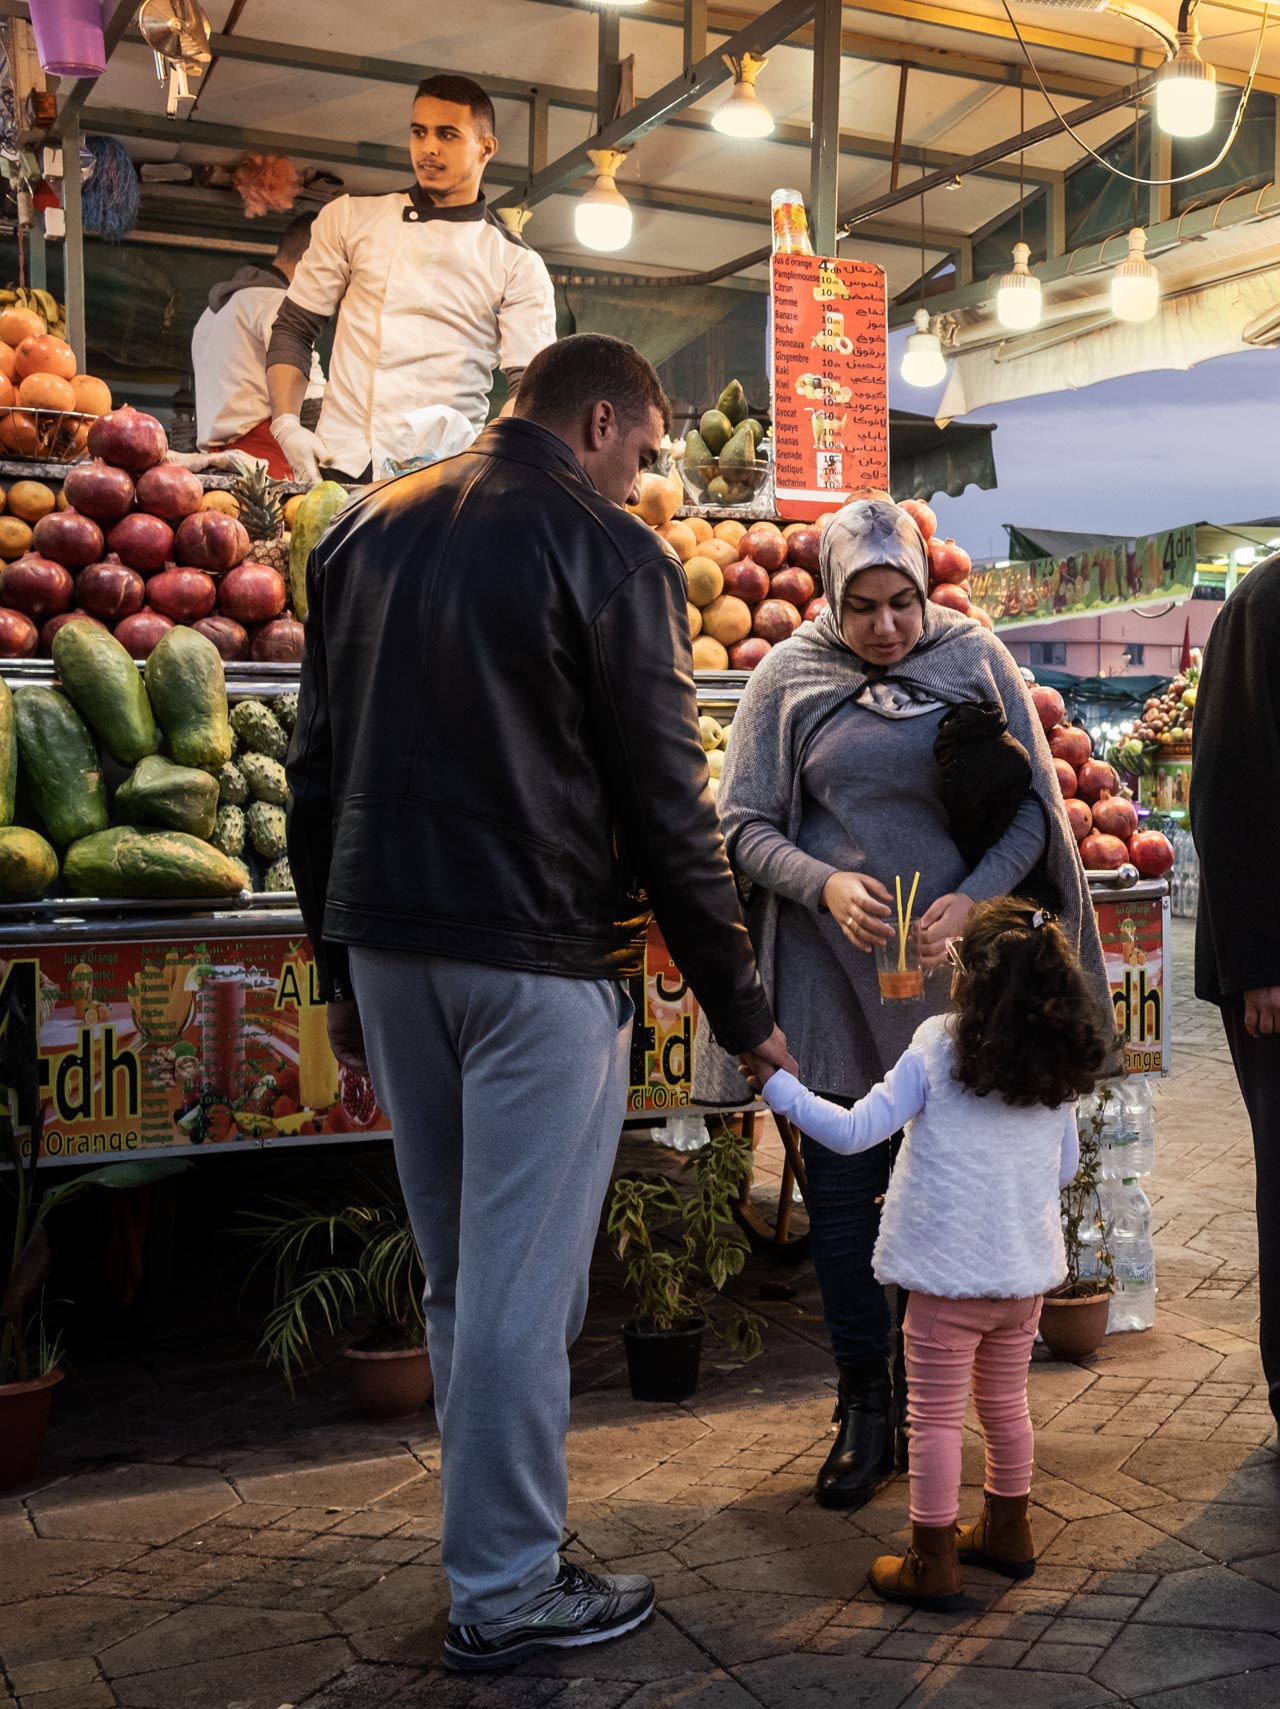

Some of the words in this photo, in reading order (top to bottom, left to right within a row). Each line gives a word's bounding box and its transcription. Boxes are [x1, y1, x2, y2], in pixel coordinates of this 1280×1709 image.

[774, 256, 784, 265] Jus
[785, 257, 812, 269] d'orange
[774, 269, 820, 283] Pamplemousse
[774, 282, 793, 292] Citron
[775, 297, 798, 307] Pomme
[776, 323, 793, 333] Peche
[866, 320, 885, 330] موز
[776, 338, 804, 348] Pruneaux
[776, 353, 809, 363] Gingembre
[776, 366, 789, 374] Kaki
[776, 380, 789, 388] Kiwi
[776, 394, 791, 403] Poire
[776, 408, 796, 417] Avocat
[776, 422, 798, 433] Papaye
[777, 436, 798, 446] Ananas
[777, 450, 802, 460] Grenade
[777, 464, 803, 475] Pastique
[777, 478, 806, 488] Nectarine
[1163, 530, 1191, 580] 4dh
[632, 1088, 689, 1109] d'Ora
